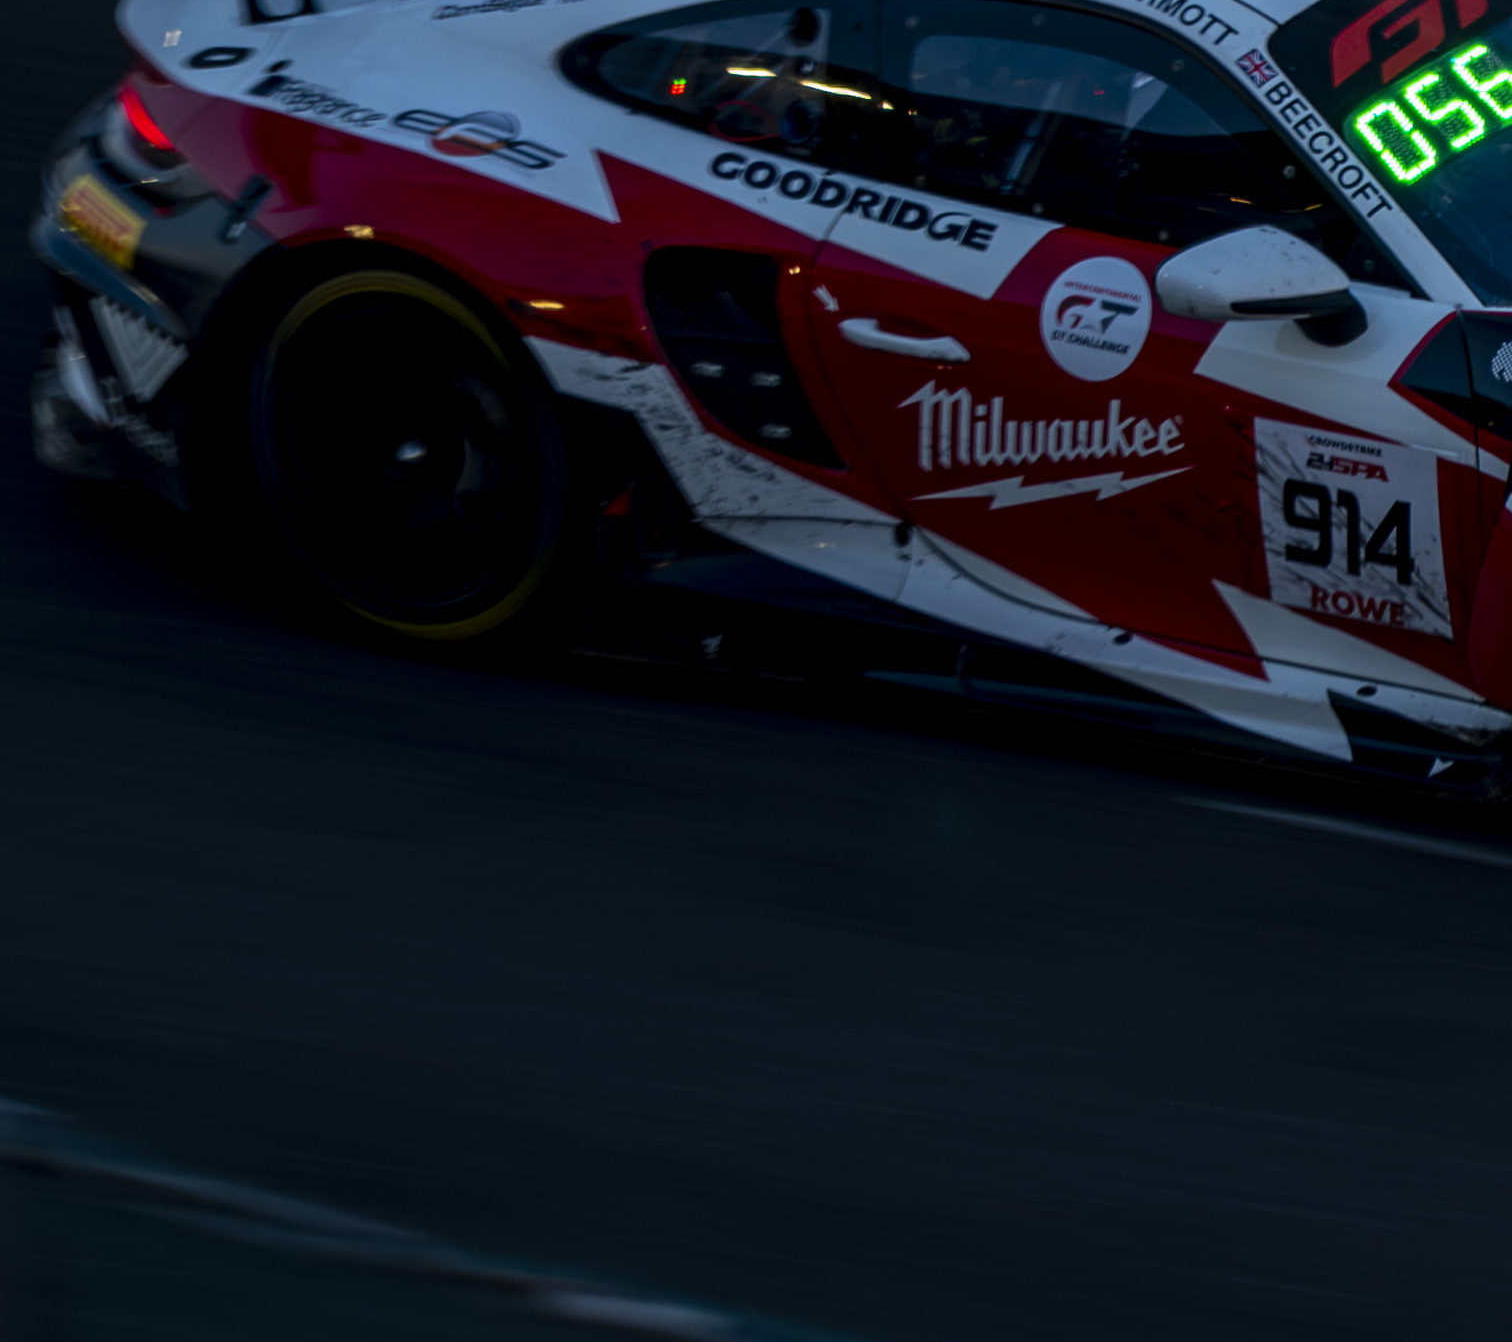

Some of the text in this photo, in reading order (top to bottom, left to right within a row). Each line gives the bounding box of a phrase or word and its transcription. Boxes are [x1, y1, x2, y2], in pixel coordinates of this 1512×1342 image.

[1264, 76, 1392, 229] BEECROFT
[710, 150, 994, 253] GOODRIDGE
[1067, 333, 1131, 355] CHALLENGE
[896, 379, 1186, 472] Milwaukee
[1307, 434, 1383, 458] CROWDSTRIKE
[1283, 478, 1415, 585] 914
[1311, 585, 1406, 627] ROWE
